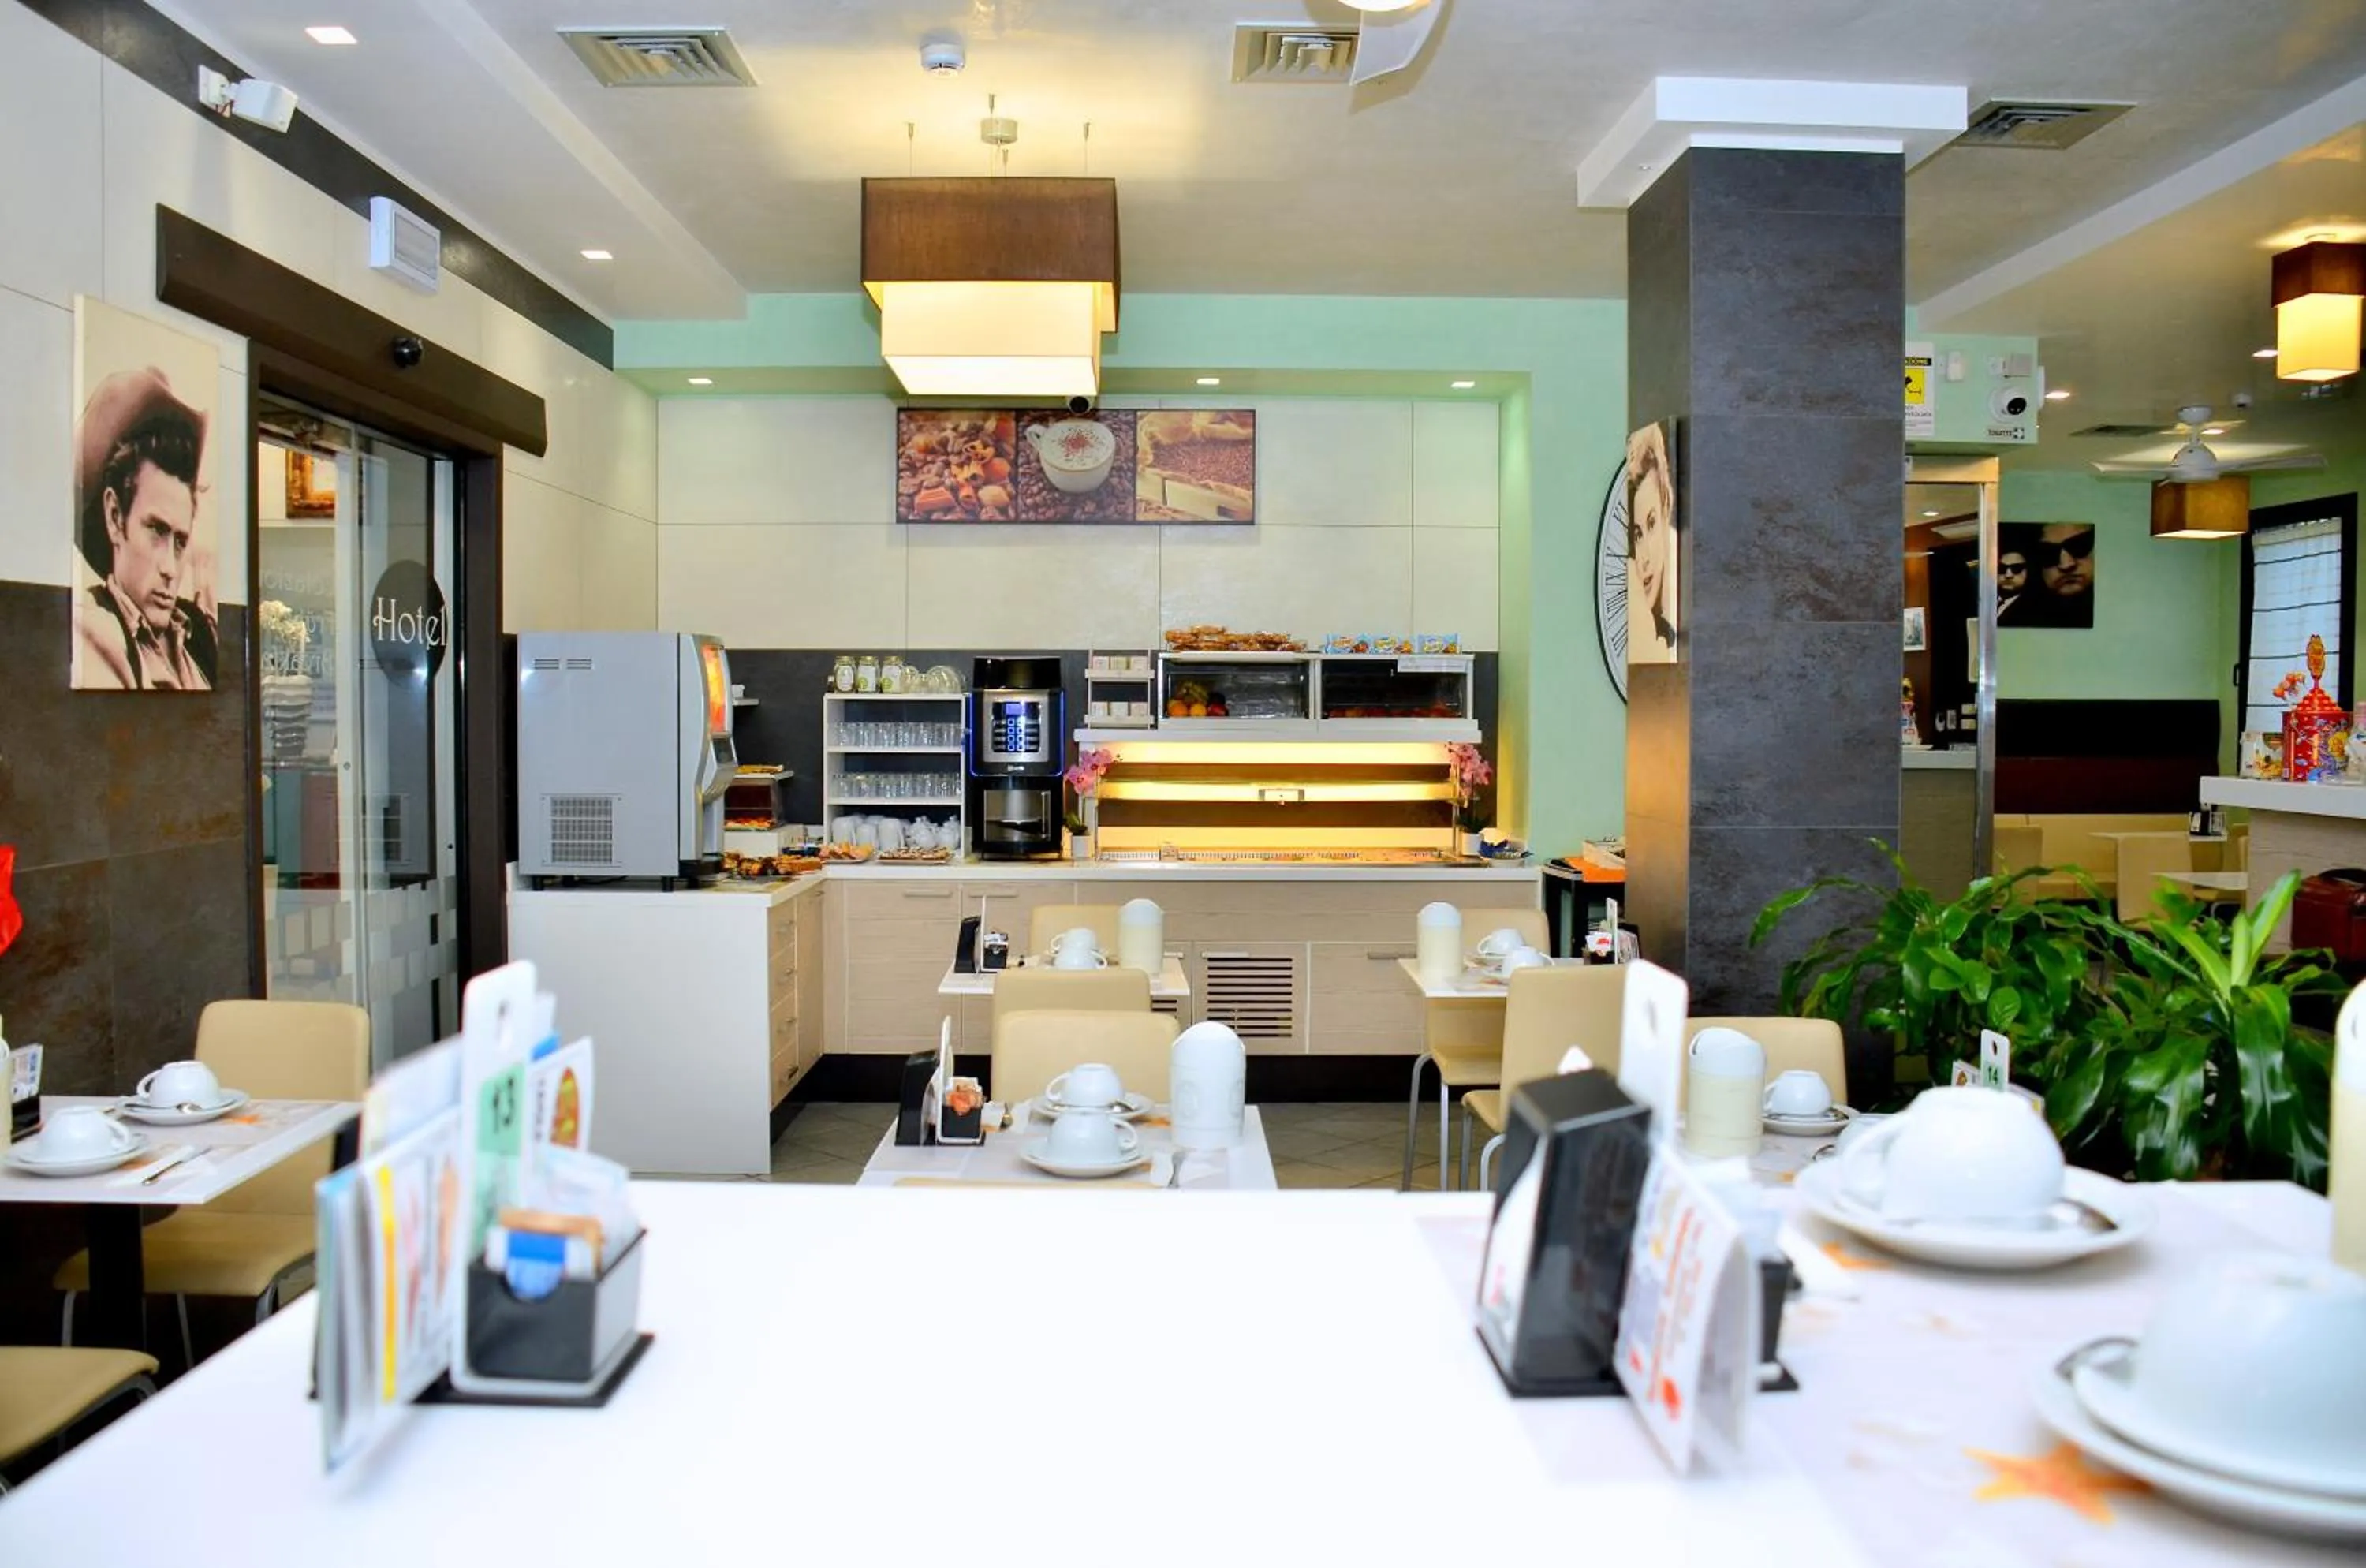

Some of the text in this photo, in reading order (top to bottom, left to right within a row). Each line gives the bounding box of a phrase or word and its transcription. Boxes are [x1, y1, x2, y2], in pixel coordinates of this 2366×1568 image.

[1606, 572, 1627, 586] IX
[373, 597, 449, 651] Hotel
[1987, 1066, 1998, 1085] 14
